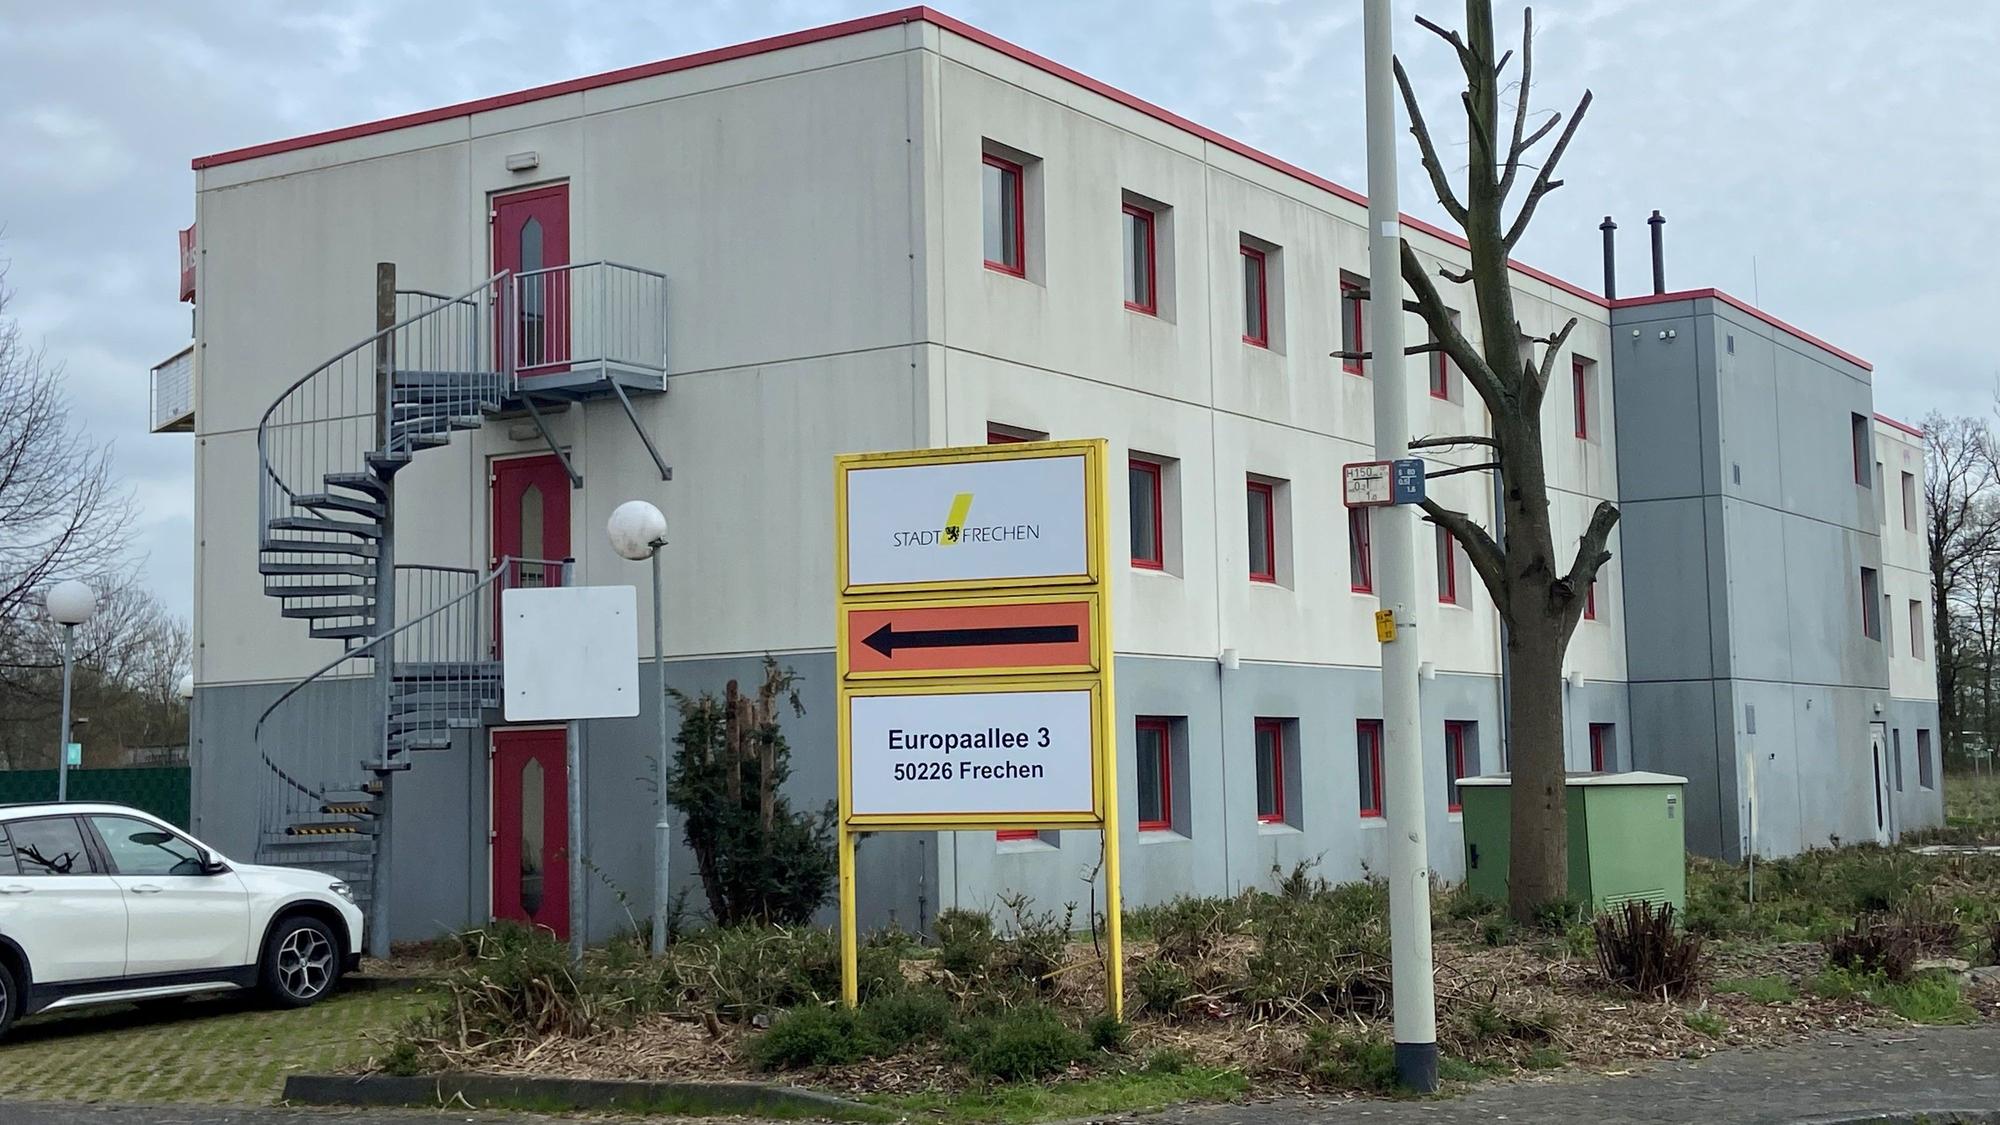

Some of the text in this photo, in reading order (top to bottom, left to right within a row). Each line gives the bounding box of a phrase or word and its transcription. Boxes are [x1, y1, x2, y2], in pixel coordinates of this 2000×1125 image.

[893, 524, 1040, 548] STADT FRECHEN
[888, 727, 1051, 754] Europaallee 3
[893, 760, 1044, 781] 50226 Frechen
